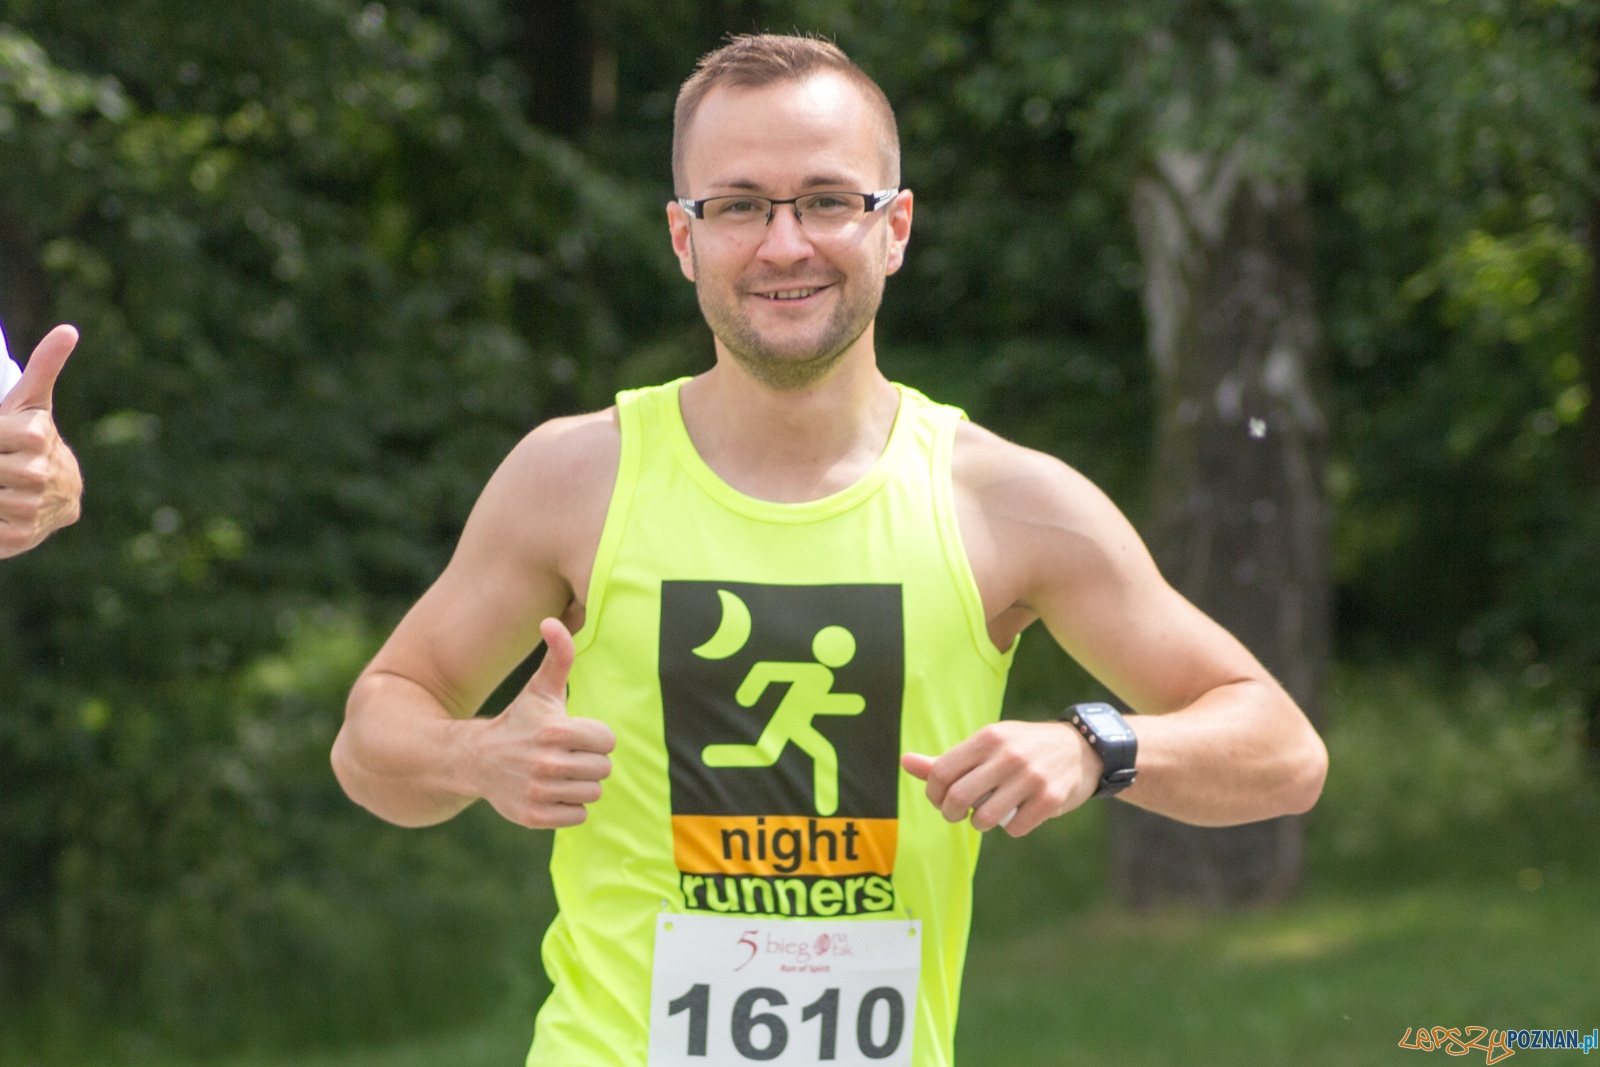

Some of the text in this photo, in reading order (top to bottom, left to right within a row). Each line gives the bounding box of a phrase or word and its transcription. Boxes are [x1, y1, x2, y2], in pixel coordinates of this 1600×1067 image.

[720, 817, 860, 873] night
[682, 874, 895, 917] runners
[733, 930, 811, 972] 5 bieg
[781, 964, 797, 972] Run
[798, 964, 808, 972] of
[667, 983, 906, 1061] 1610
